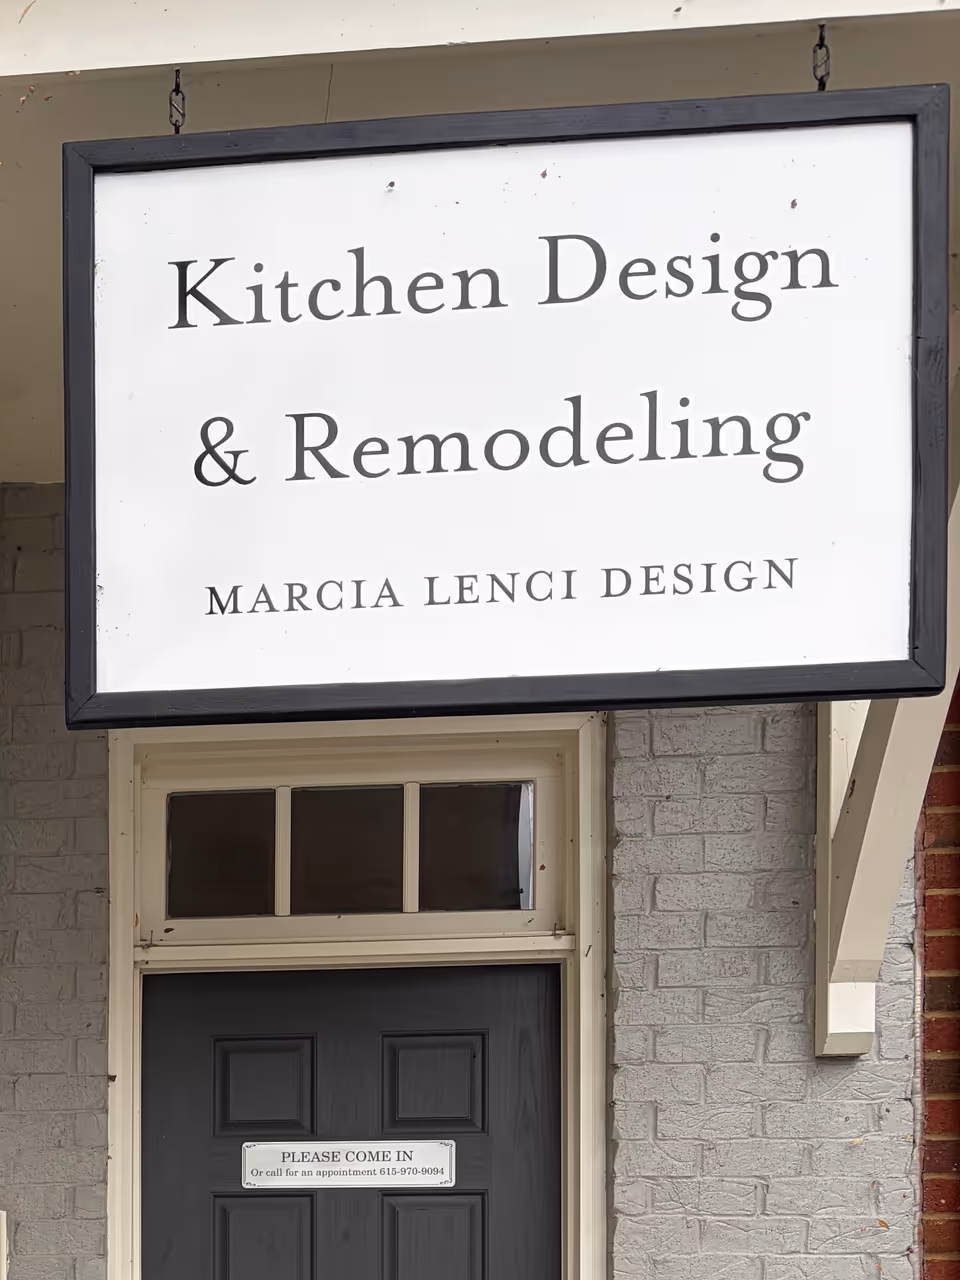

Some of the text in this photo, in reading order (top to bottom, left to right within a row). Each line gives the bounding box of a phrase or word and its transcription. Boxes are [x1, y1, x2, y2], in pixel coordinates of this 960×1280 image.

[167, 232, 839, 330] Kitchen Design
[193, 390, 811, 487] & Remodeling
[205, 557, 799, 616] MARCIA LENCI DESIGN
[250, 1167, 445, 1178] Or call for an appointment 615-970-9094
[280, 1150, 414, 1163] PLEASE COME IN
